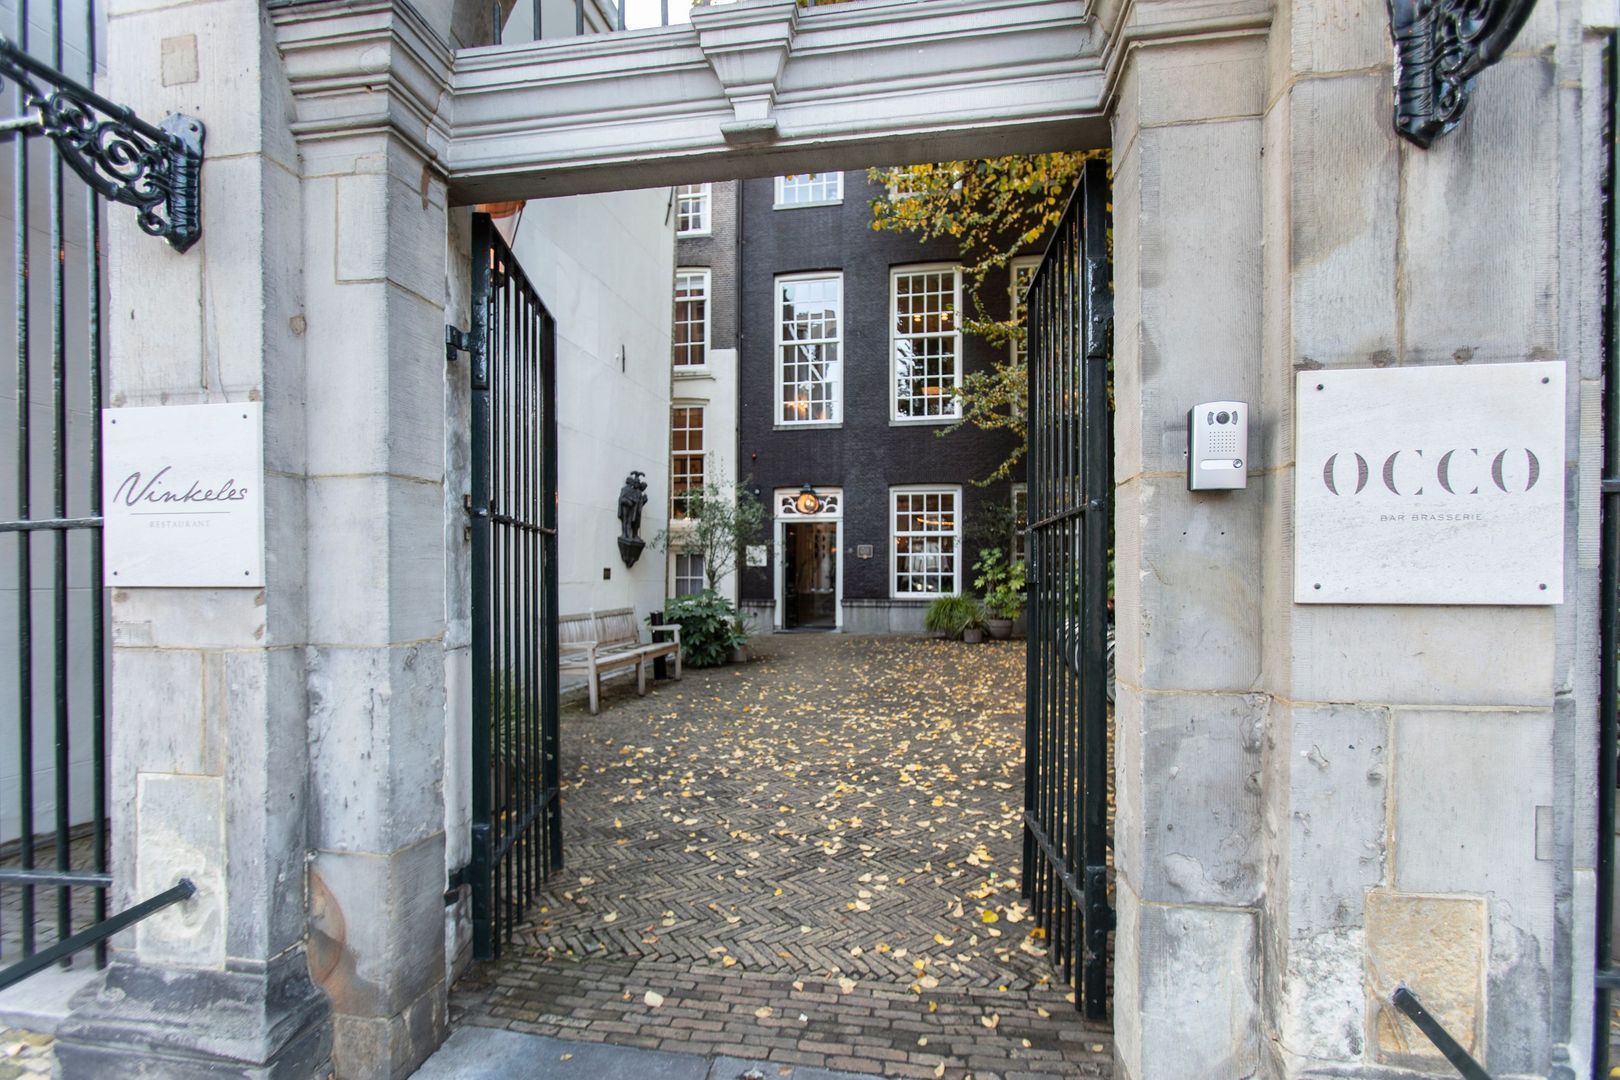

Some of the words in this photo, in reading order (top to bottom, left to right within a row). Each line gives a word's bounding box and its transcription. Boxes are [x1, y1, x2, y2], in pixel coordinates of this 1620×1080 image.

[1323, 448, 1540, 496] OCCO
[113, 465, 248, 507] Vinkeles
[149, 520, 211, 529] RESTAURANT
[1380, 513, 1405, 522] BAR
[1411, 512, 1483, 522] BRASSERIE
